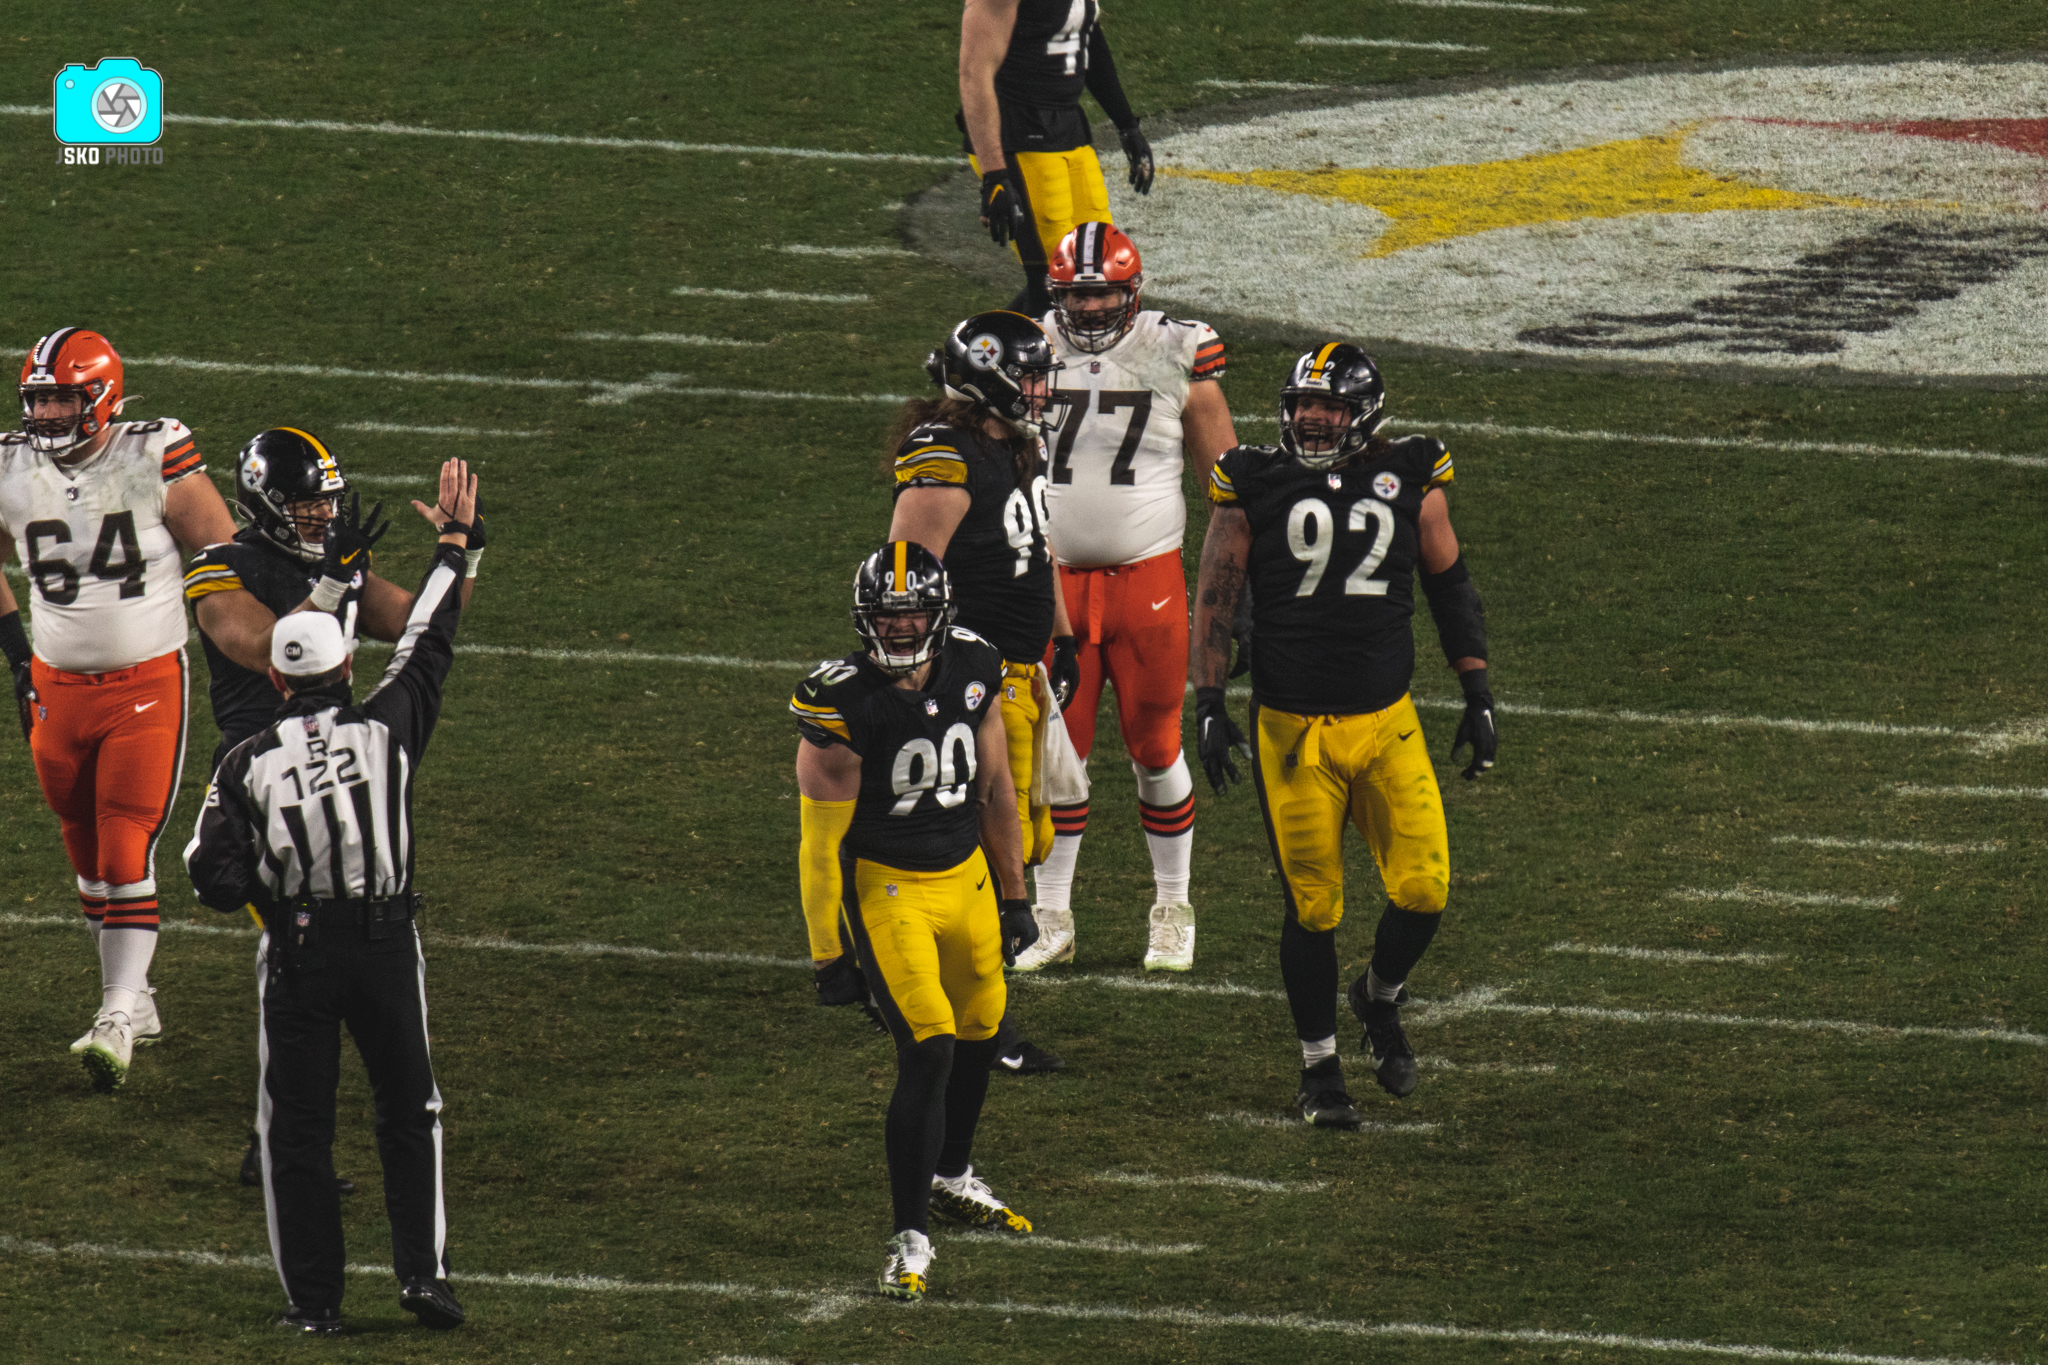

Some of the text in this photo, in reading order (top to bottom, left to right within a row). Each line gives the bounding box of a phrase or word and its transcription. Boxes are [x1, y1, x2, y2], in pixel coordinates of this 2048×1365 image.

[1302, 359, 1336, 380] 92
[1043, 389, 1153, 485] 77
[26, 510, 147, 606] 64
[1287, 497, 1396, 598] 92
[884, 570, 918, 591] 90
[286, 645, 301, 656] CM
[808, 659, 859, 686] 90
[306, 738, 328, 760] R
[888, 722, 977, 816] 90
[281, 747, 362, 801] 122
